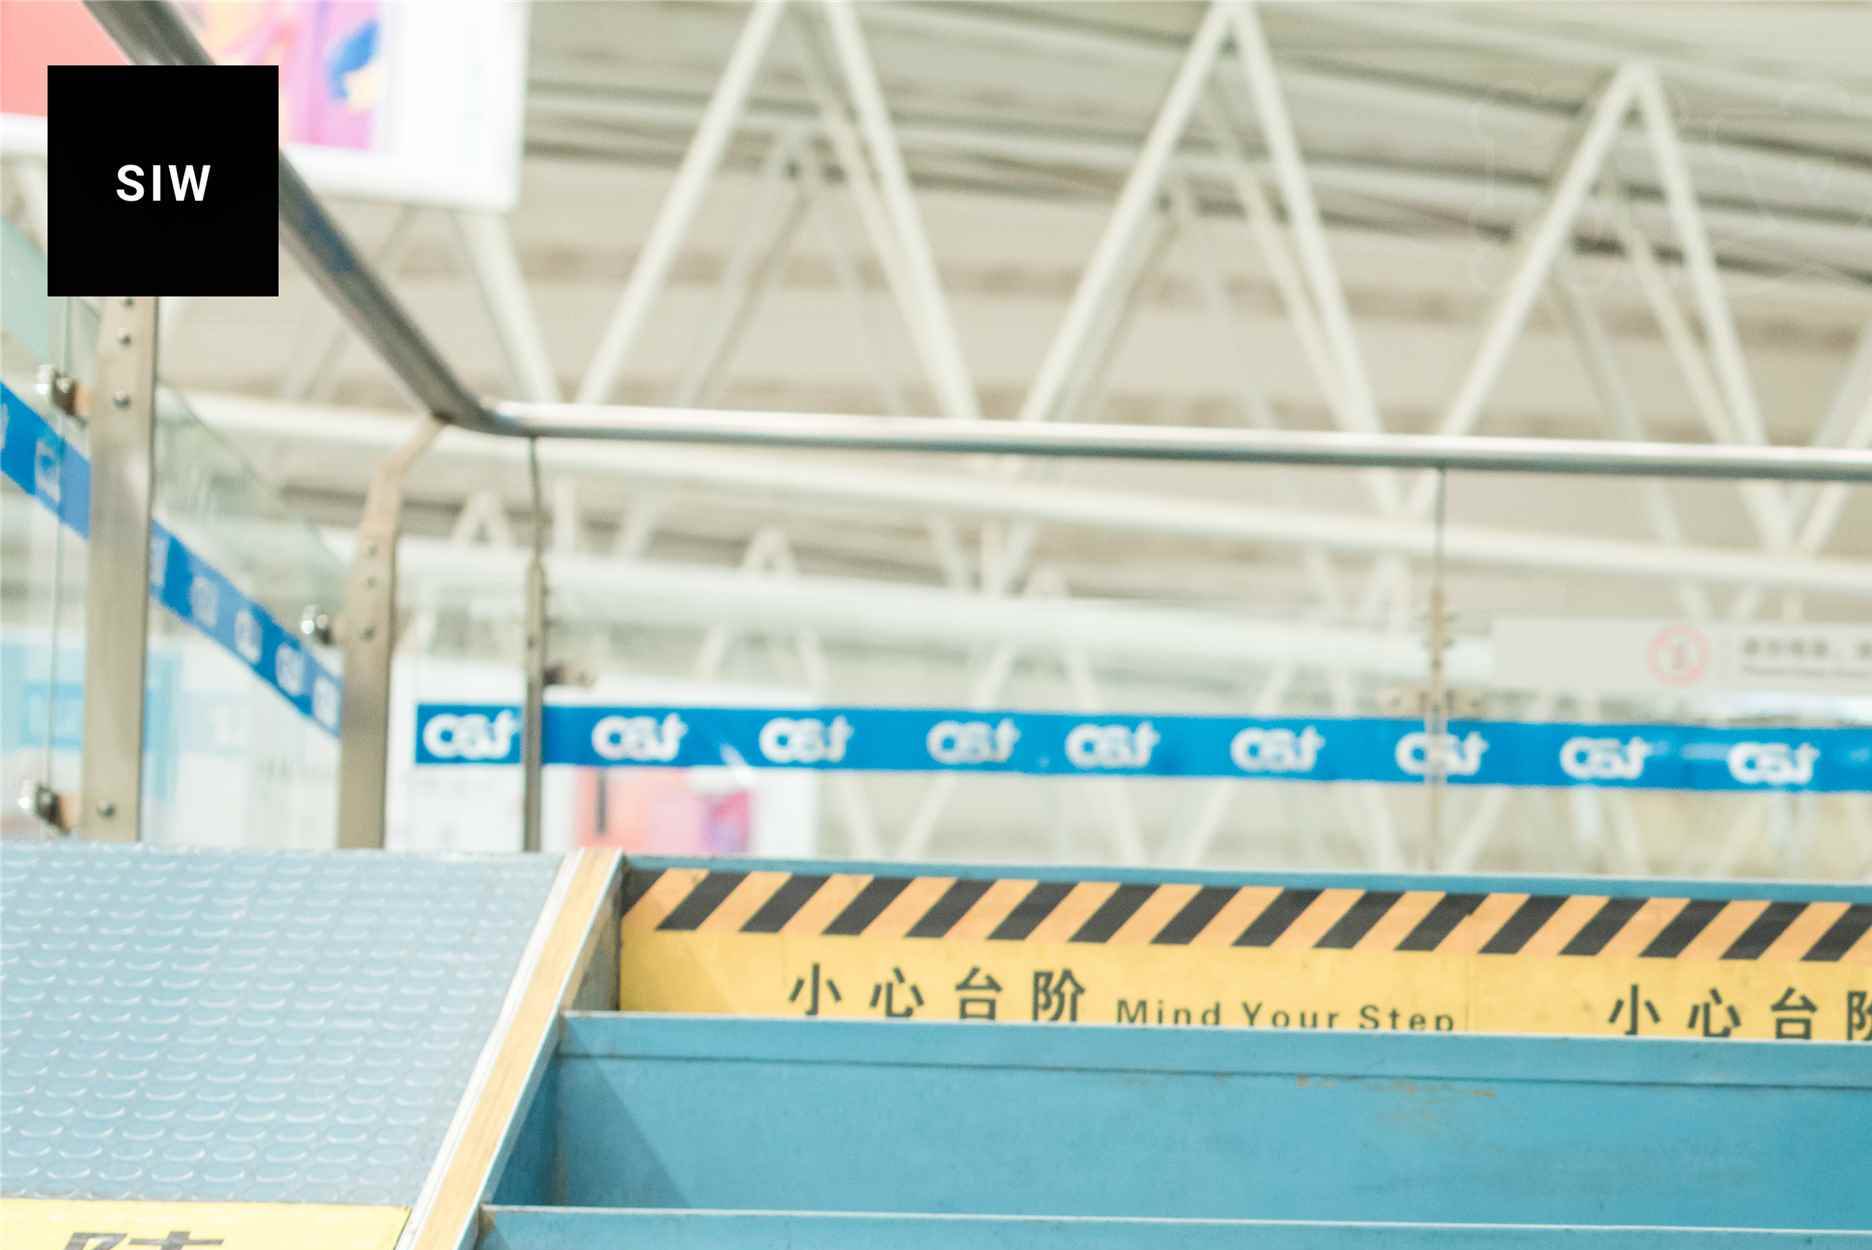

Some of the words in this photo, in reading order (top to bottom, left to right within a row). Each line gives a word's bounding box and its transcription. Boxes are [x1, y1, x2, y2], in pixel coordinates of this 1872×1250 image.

[788, 962, 1087, 1023] 小心台阶
[1116, 998, 1221, 1027] Mind
[1241, 1001, 1339, 1029] Your
[1358, 1004, 1456, 1032] Step
